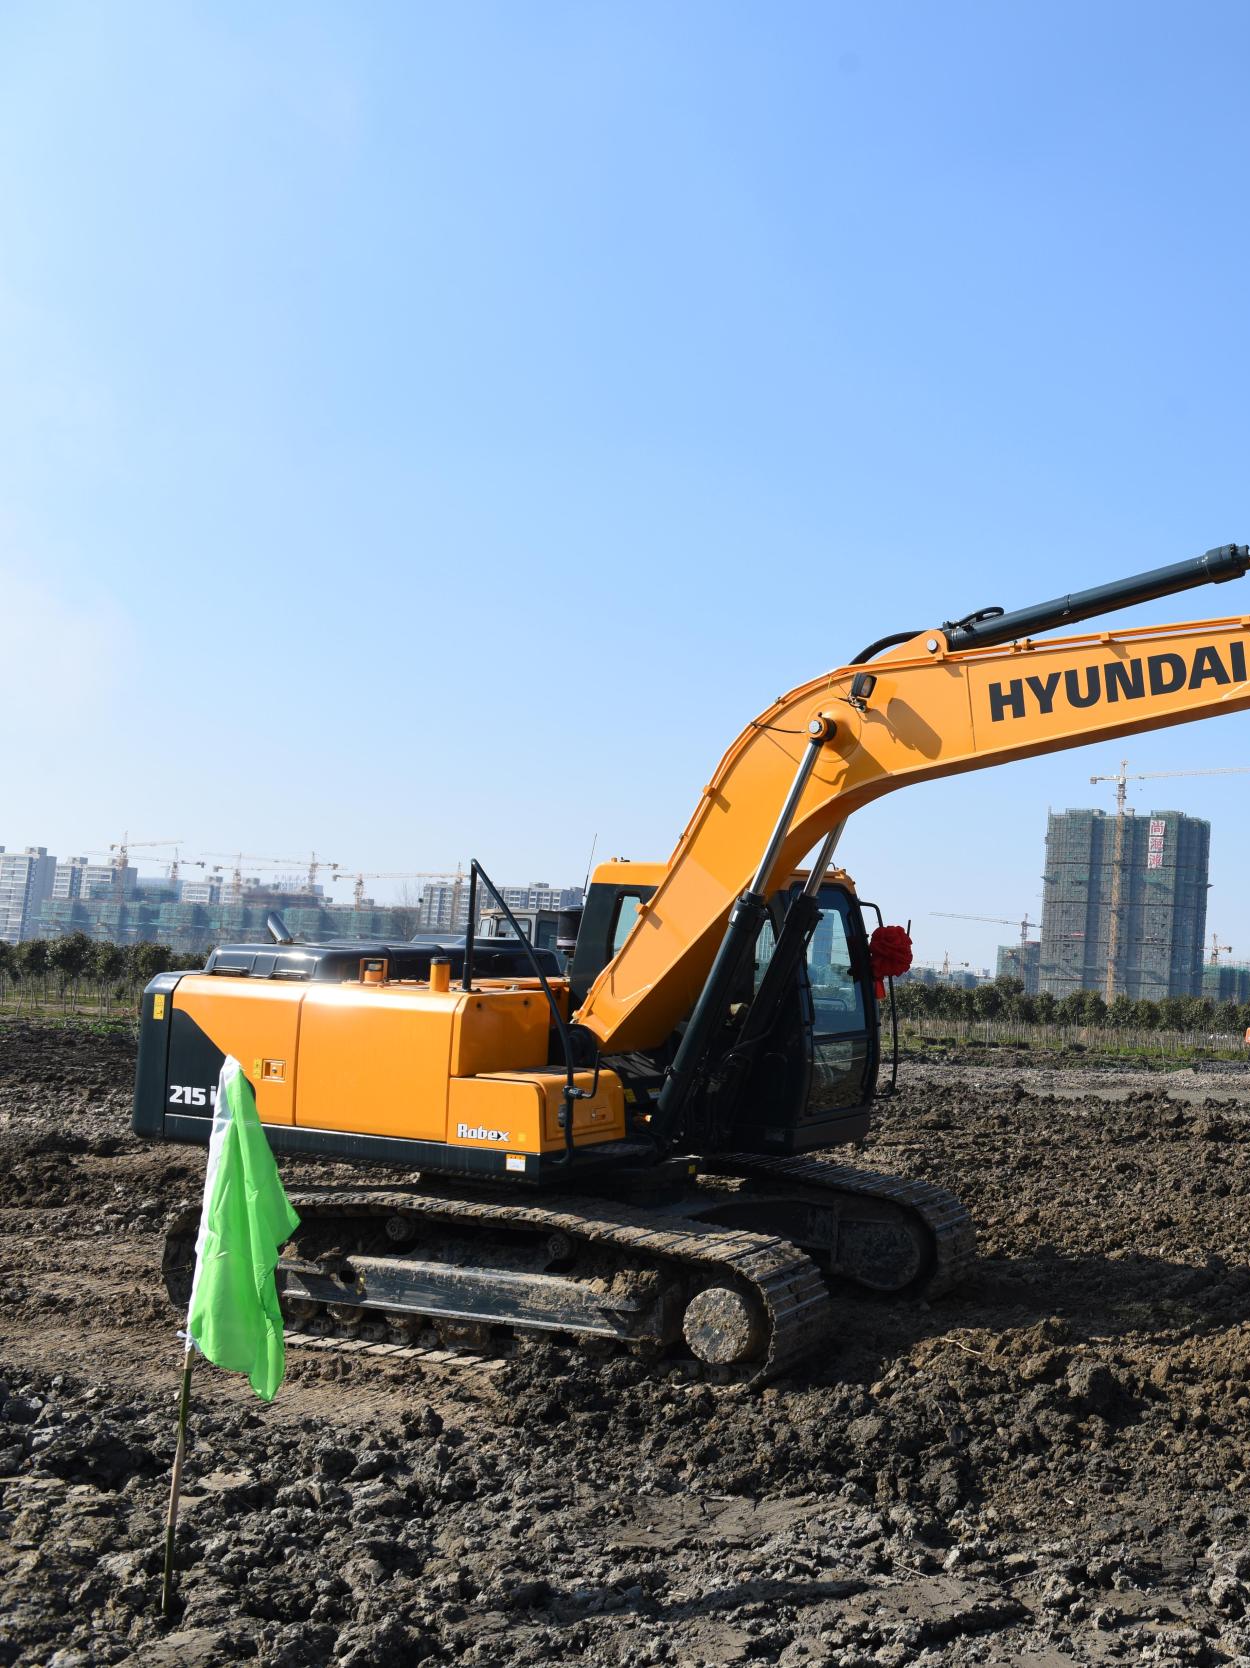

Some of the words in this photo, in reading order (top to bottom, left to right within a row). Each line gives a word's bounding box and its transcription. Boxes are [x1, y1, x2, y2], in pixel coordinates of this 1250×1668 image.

[988, 641, 1248, 722] HYUNDAI
[169, 1085, 206, 1106] 215
[457, 1123, 510, 1142] Robex
